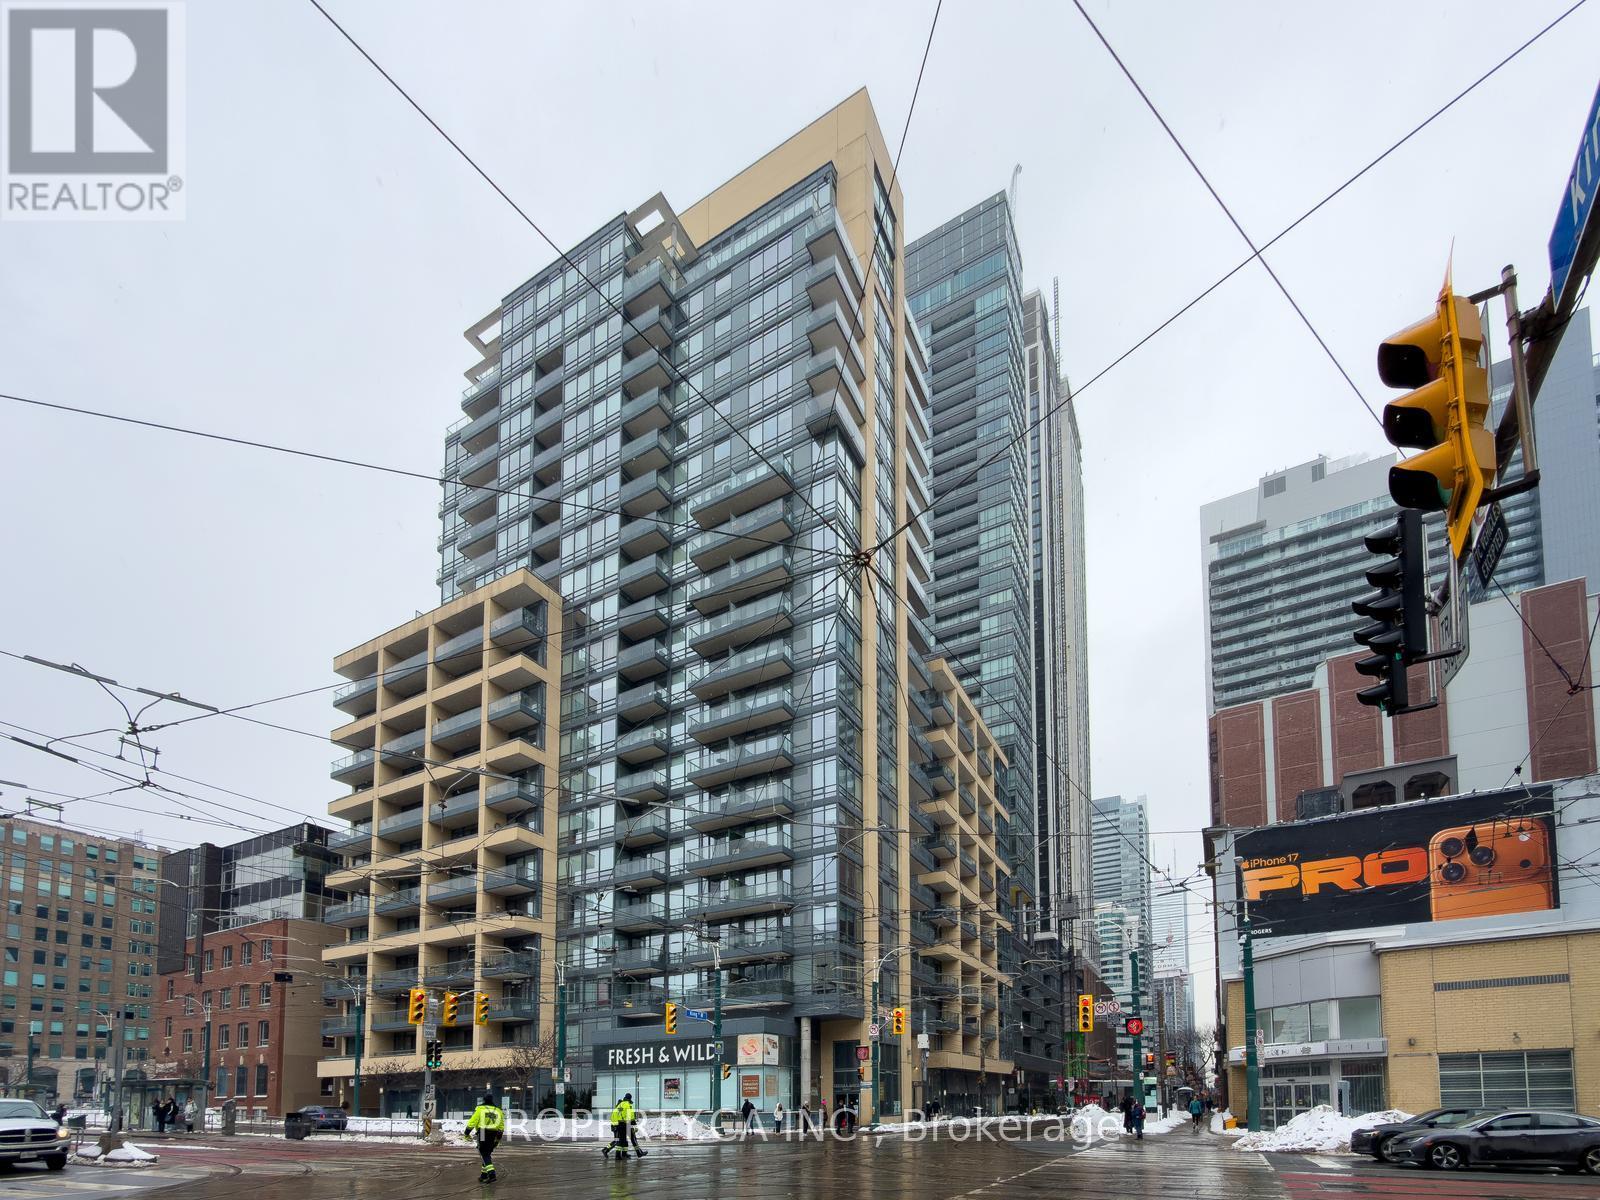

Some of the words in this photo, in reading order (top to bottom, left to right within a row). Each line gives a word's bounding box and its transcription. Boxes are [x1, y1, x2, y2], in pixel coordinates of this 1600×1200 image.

[1481, 527, 1504, 578] EXCEPTED
[1243, 847, 1428, 901] PRO
[1250, 856, 1287, 869] iPhone
[1287, 852, 1299, 862] 17
[608, 1047, 654, 1066] FRESH
[658, 1045, 670, 1064] &
[673, 1043, 716, 1063] WILD
